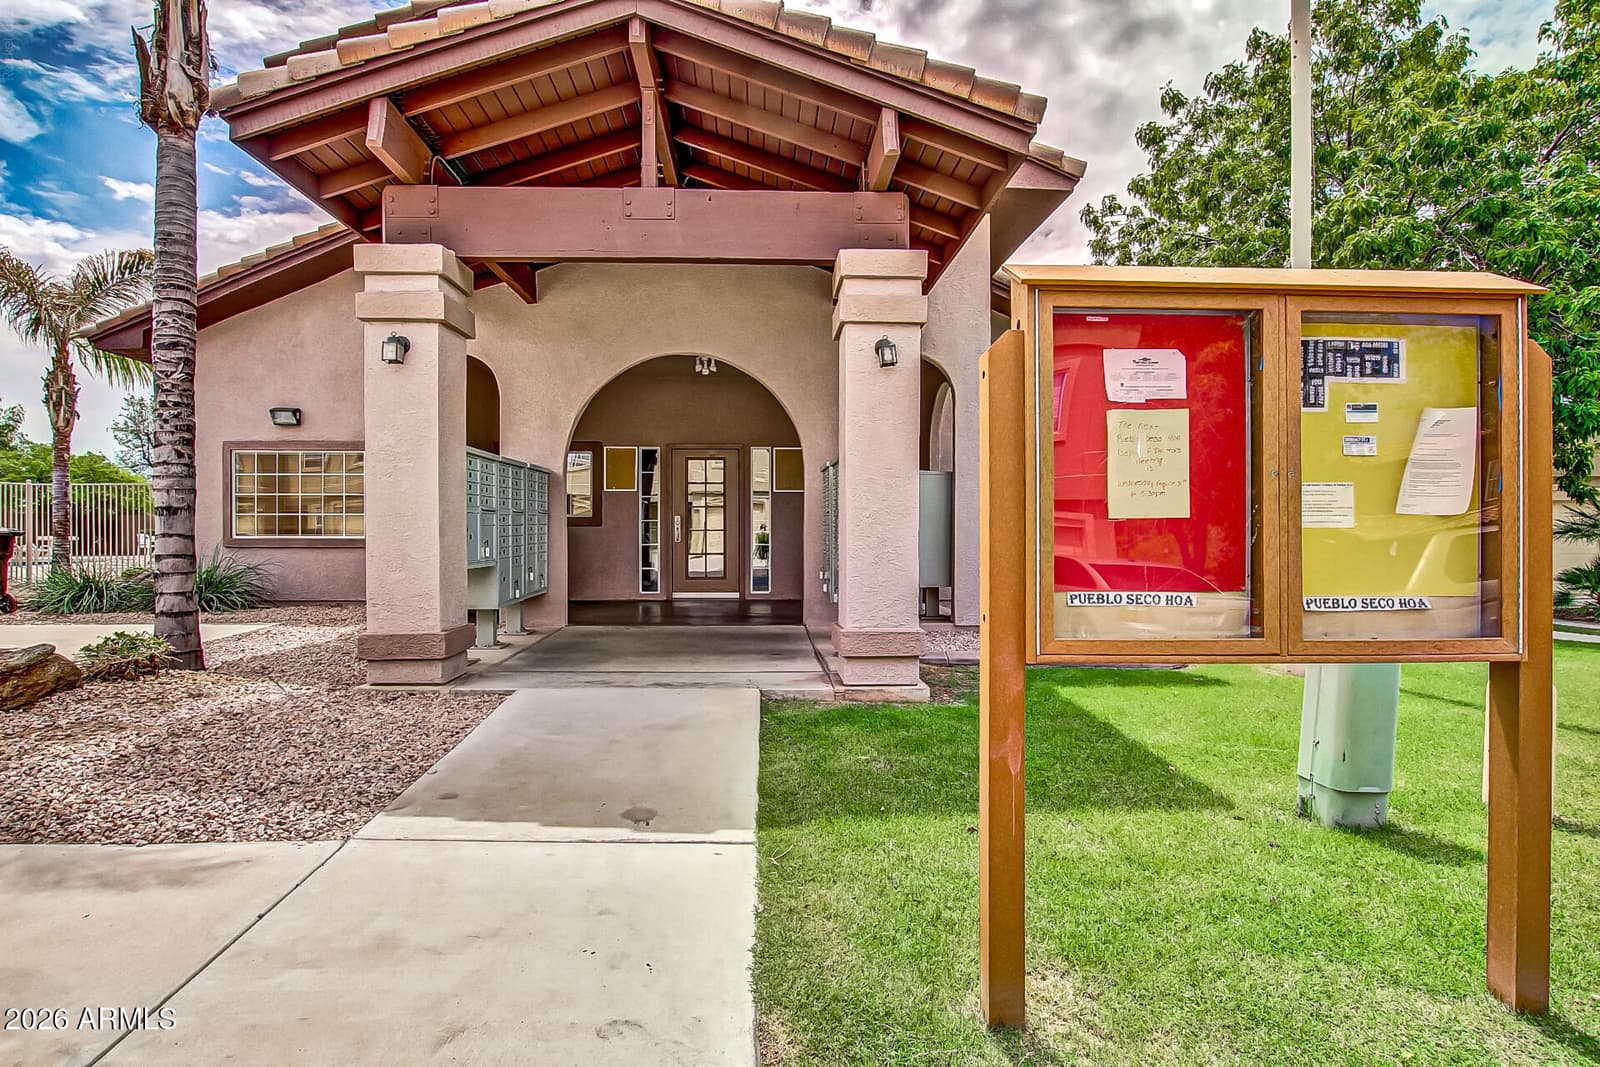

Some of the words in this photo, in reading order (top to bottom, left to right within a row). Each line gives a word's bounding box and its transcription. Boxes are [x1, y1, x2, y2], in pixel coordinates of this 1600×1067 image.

[1069, 593, 1122, 605] PUEBLO
[1126, 593, 1161, 605] SECO
[1165, 594, 1194, 606] HOA
[1305, 598, 1357, 609] PUEBLO
[1361, 598, 1395, 609] SECO
[1399, 598, 1428, 608] HOA
